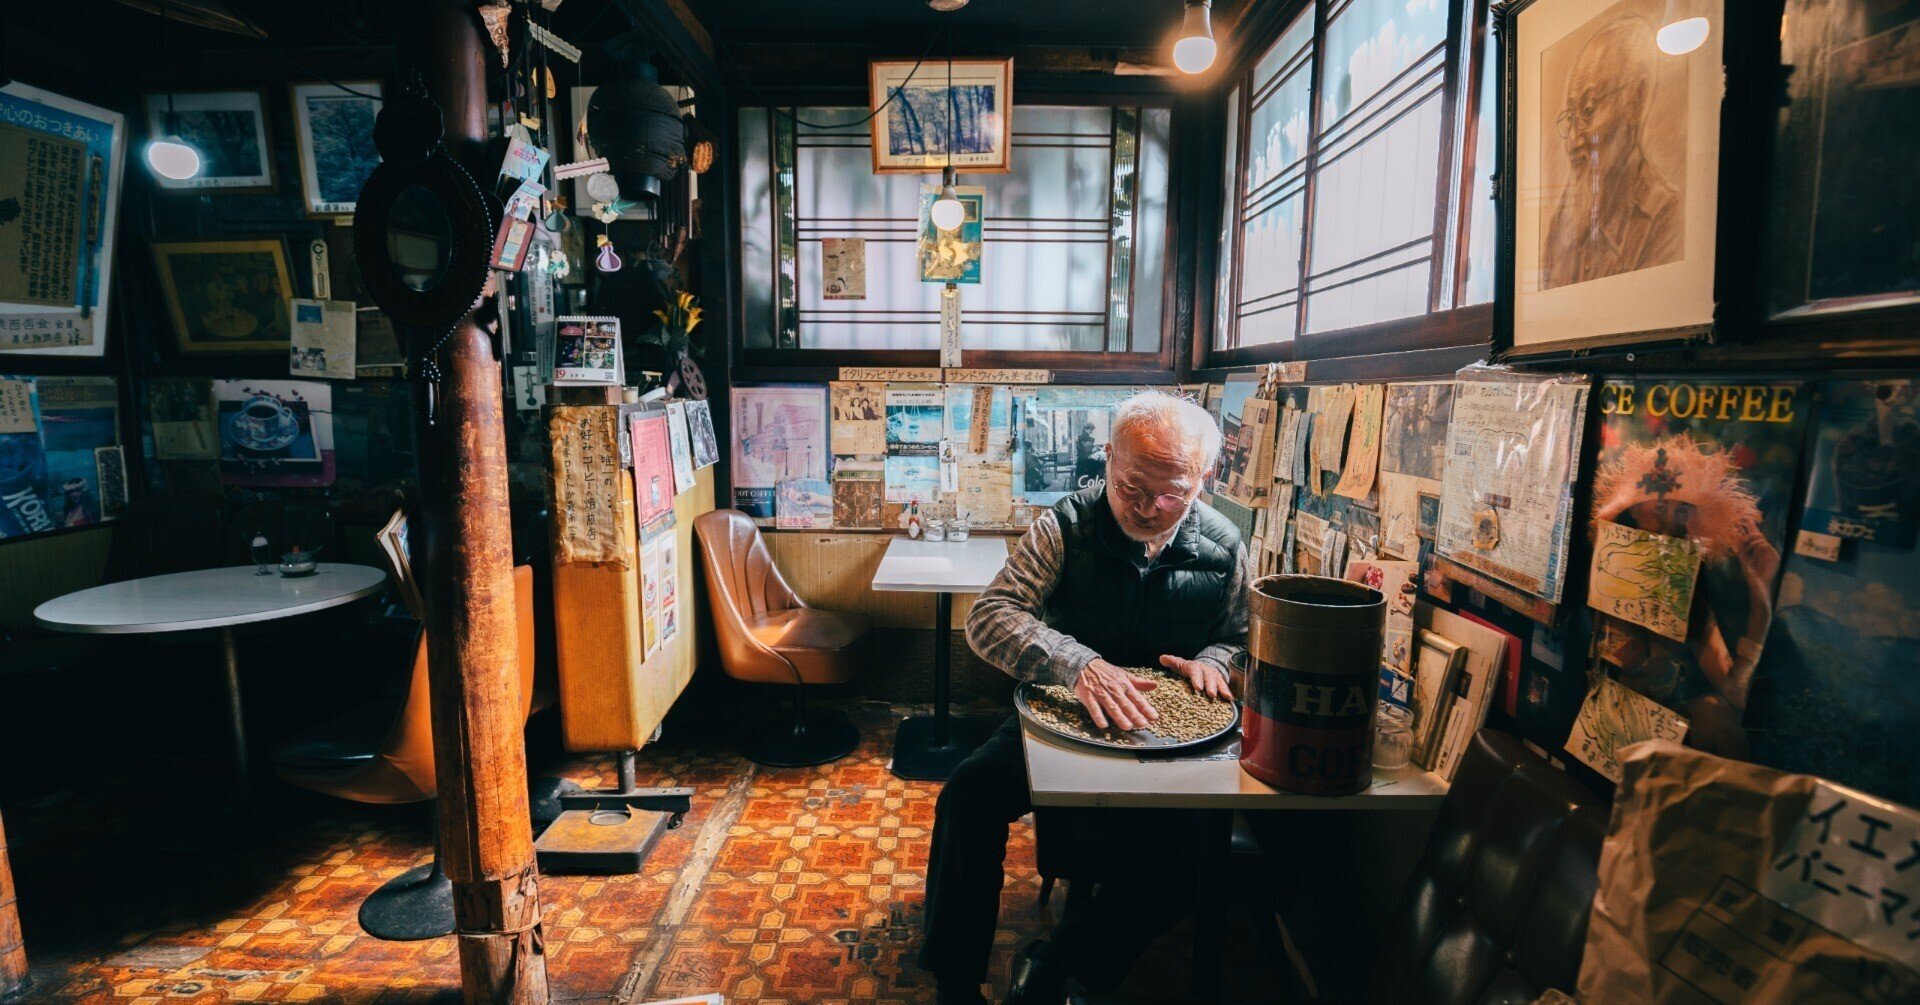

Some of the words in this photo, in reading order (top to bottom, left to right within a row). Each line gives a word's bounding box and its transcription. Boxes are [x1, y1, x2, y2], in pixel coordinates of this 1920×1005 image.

[1647, 383, 1797, 422] COFFEE
[1827, 516, 1876, 541] 氷カフェ
